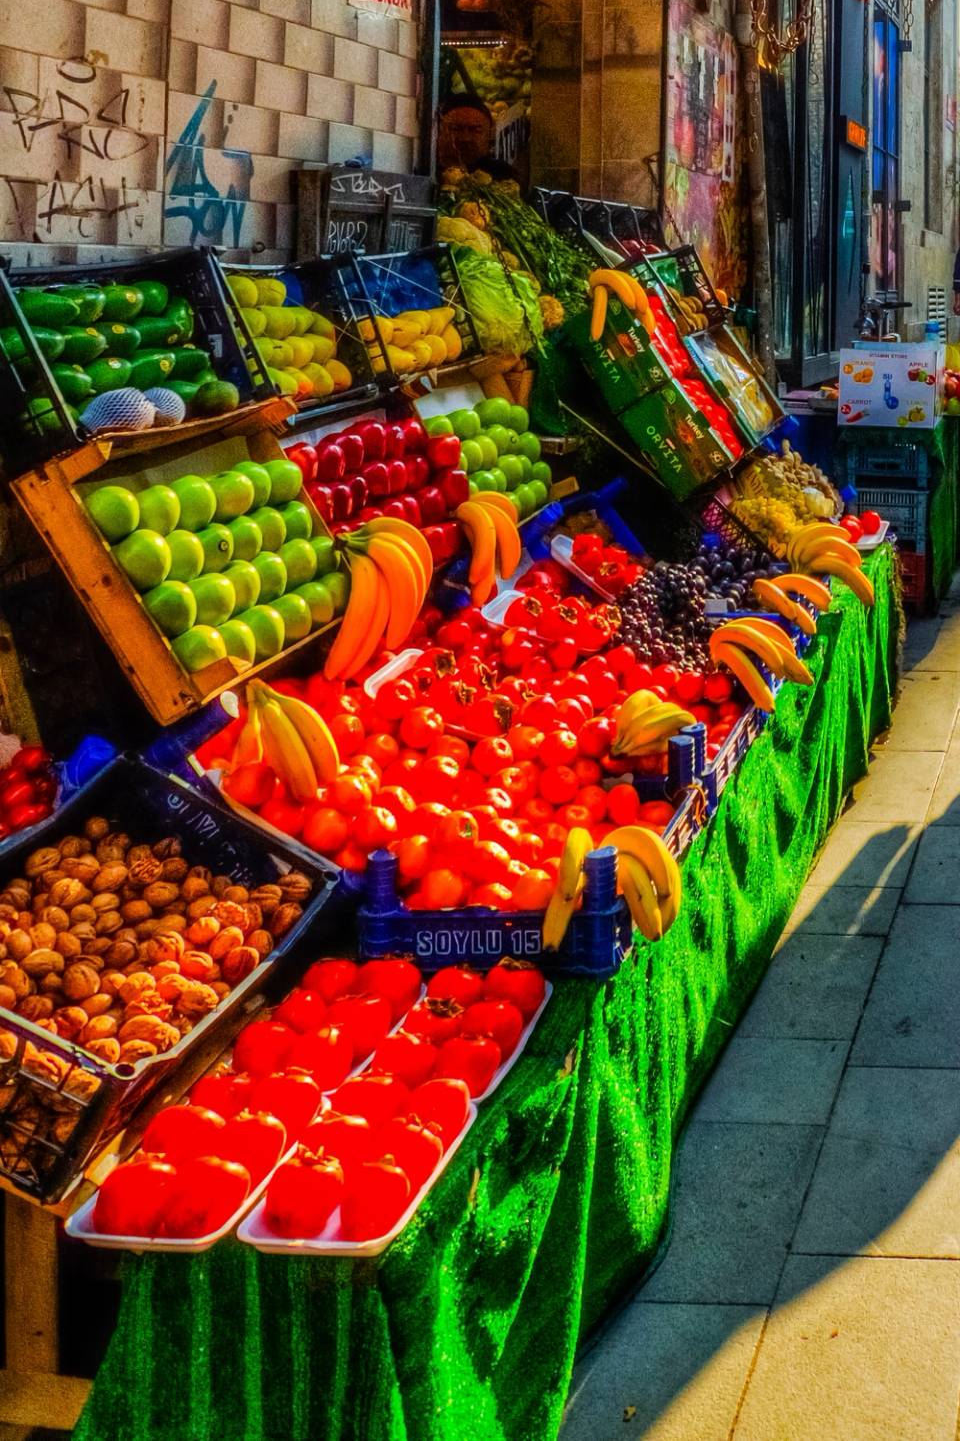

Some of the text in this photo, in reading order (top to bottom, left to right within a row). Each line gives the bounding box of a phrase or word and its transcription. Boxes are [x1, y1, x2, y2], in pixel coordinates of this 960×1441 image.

[627, 326, 646, 353] Turkey
[593, 343, 621, 384] RVITA
[684, 414, 705, 440] Turkey
[646, 425, 683, 474] ORVITA
[416, 929, 541, 956] SOYLU 15
